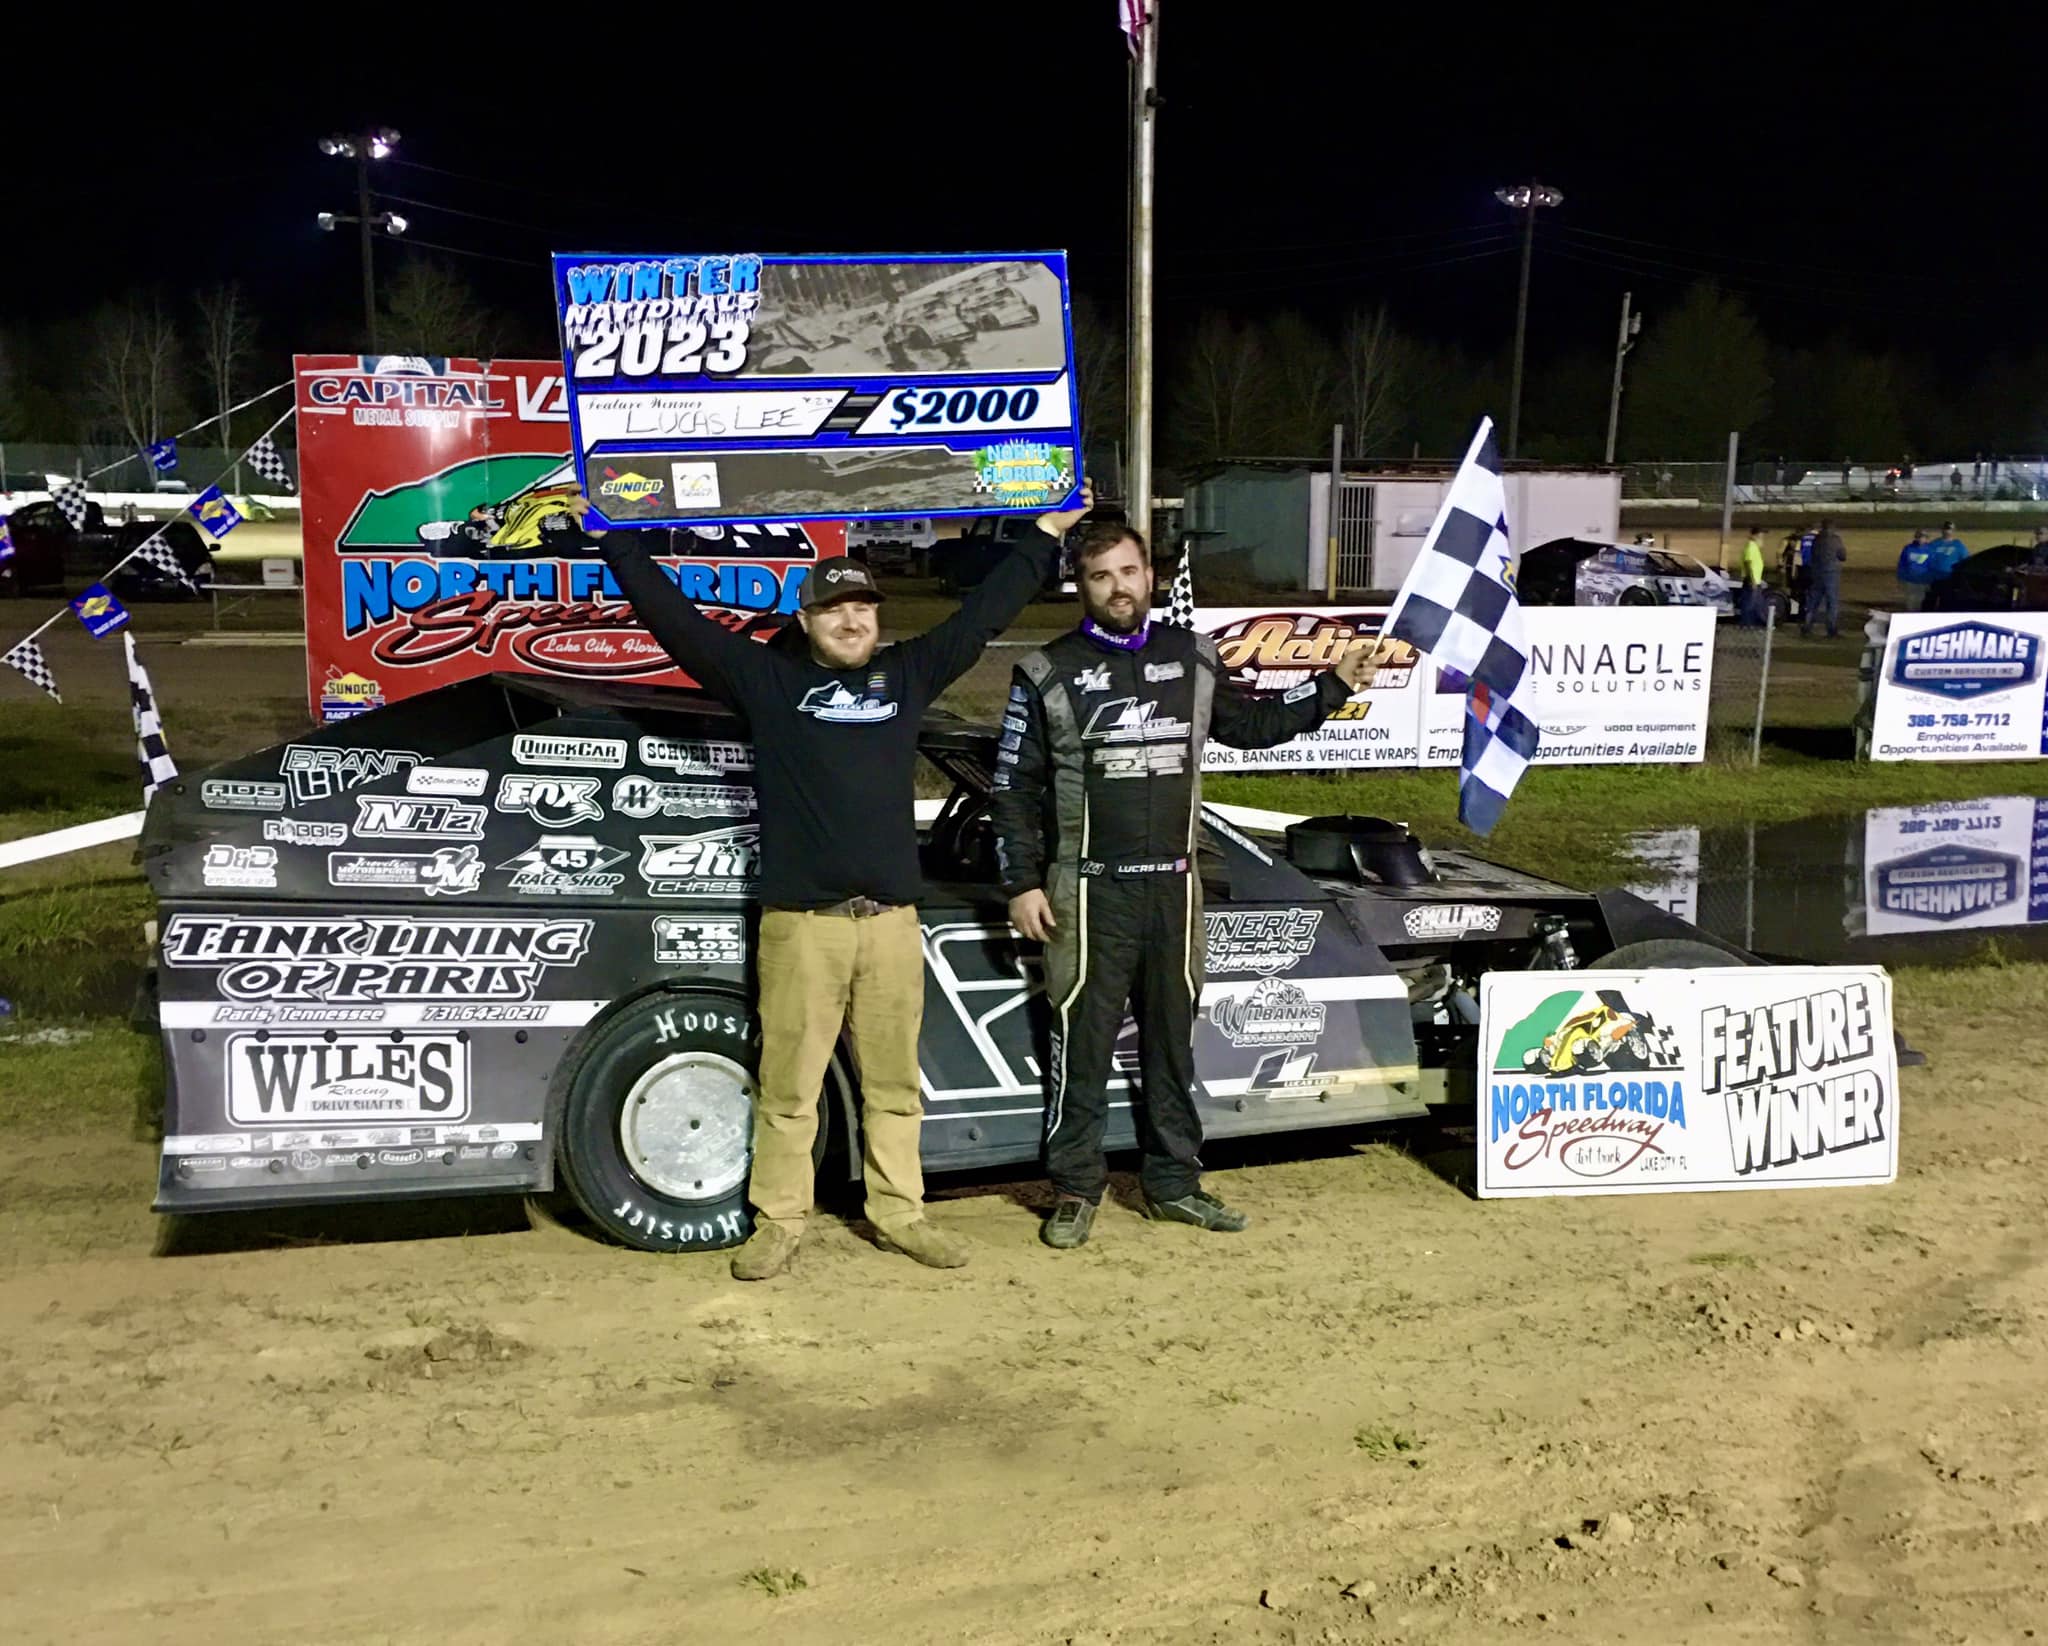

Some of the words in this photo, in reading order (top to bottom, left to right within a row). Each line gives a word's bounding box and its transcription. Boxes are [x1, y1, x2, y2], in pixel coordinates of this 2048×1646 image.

[567, 254, 762, 306] WINTER
[565, 294, 761, 332] NATIONALS
[574, 320, 750, 378] 2023
[309, 378, 504, 409] CAPITAL
[354, 408, 403, 425] METAL
[890, 387, 1040, 429] $2000
[626, 408, 727, 435] LUCAS
[733, 405, 803, 430] LEE
[987, 443, 1050, 462] NORTH
[983, 464, 1059, 484] FLORIDA
[603, 480, 661, 494] SUNOCO
[343, 561, 556, 634] NORTH
[571, 561, 810, 616] FLRIDA
[543, 638, 580, 653] Lake
[585, 638, 617, 657] City,
[1905, 629, 2030, 660] CUSHMAN'S
[1530, 642, 1703, 676] NNACLE
[327, 681, 377, 695] SUNOCO
[1556, 678, 1702, 694] SOLUTIONS
[1300, 727, 1390, 742] INSTALLATION
[1917, 731, 1997, 742] Employment
[1202, 752, 1238, 766] IGNS,
[1242, 749, 1303, 763] BANNERS
[1306, 749, 1315, 762] &
[1319, 747, 1371, 761] VEHICLE
[1373, 744, 1418, 760] WRAPS
[1532, 741, 1624, 760] pportunities
[1628, 740, 1697, 757] Available
[1878, 743, 1969, 756] Opportunities
[1972, 742, 2028, 753] Available
[504, 780, 593, 809] FOX
[550, 850, 588, 868] 45
[1118, 863, 1155, 872] LUCAS
[1157, 862, 1175, 871] LEE
[513, 873, 562, 886] RACE
[567, 874, 622, 887] SHOP
[170, 918, 356, 960] TANK
[372, 919, 587, 961] LINING
[666, 923, 739, 940] FK
[658, 951, 739, 960] ENDS
[676, 941, 739, 950] ROD
[226, 960, 331, 1000] OF
[333, 960, 534, 1000] PARIS
[214, 1007, 274, 1023] Paris,
[280, 1008, 384, 1022] Tennessee
[421, 1006, 547, 1022] 731.642.0211
[655, 1008, 750, 1043] Hoosi
[1214, 996, 1322, 1034] WILBANKS
[1701, 983, 1875, 1094] FEATURE
[245, 1042, 453, 1113] WILES
[327, 1084, 389, 1096] Racing
[312, 1099, 403, 1111] DRIVESHAFTS
[1492, 1084, 1576, 1143] NORTH
[1583, 1081, 1686, 1130] FLORIDA
[1724, 1069, 1885, 1175] WINNER
[1504, 1107, 1665, 1170] Speedway
[613, 1201, 741, 1243] Hoosier
